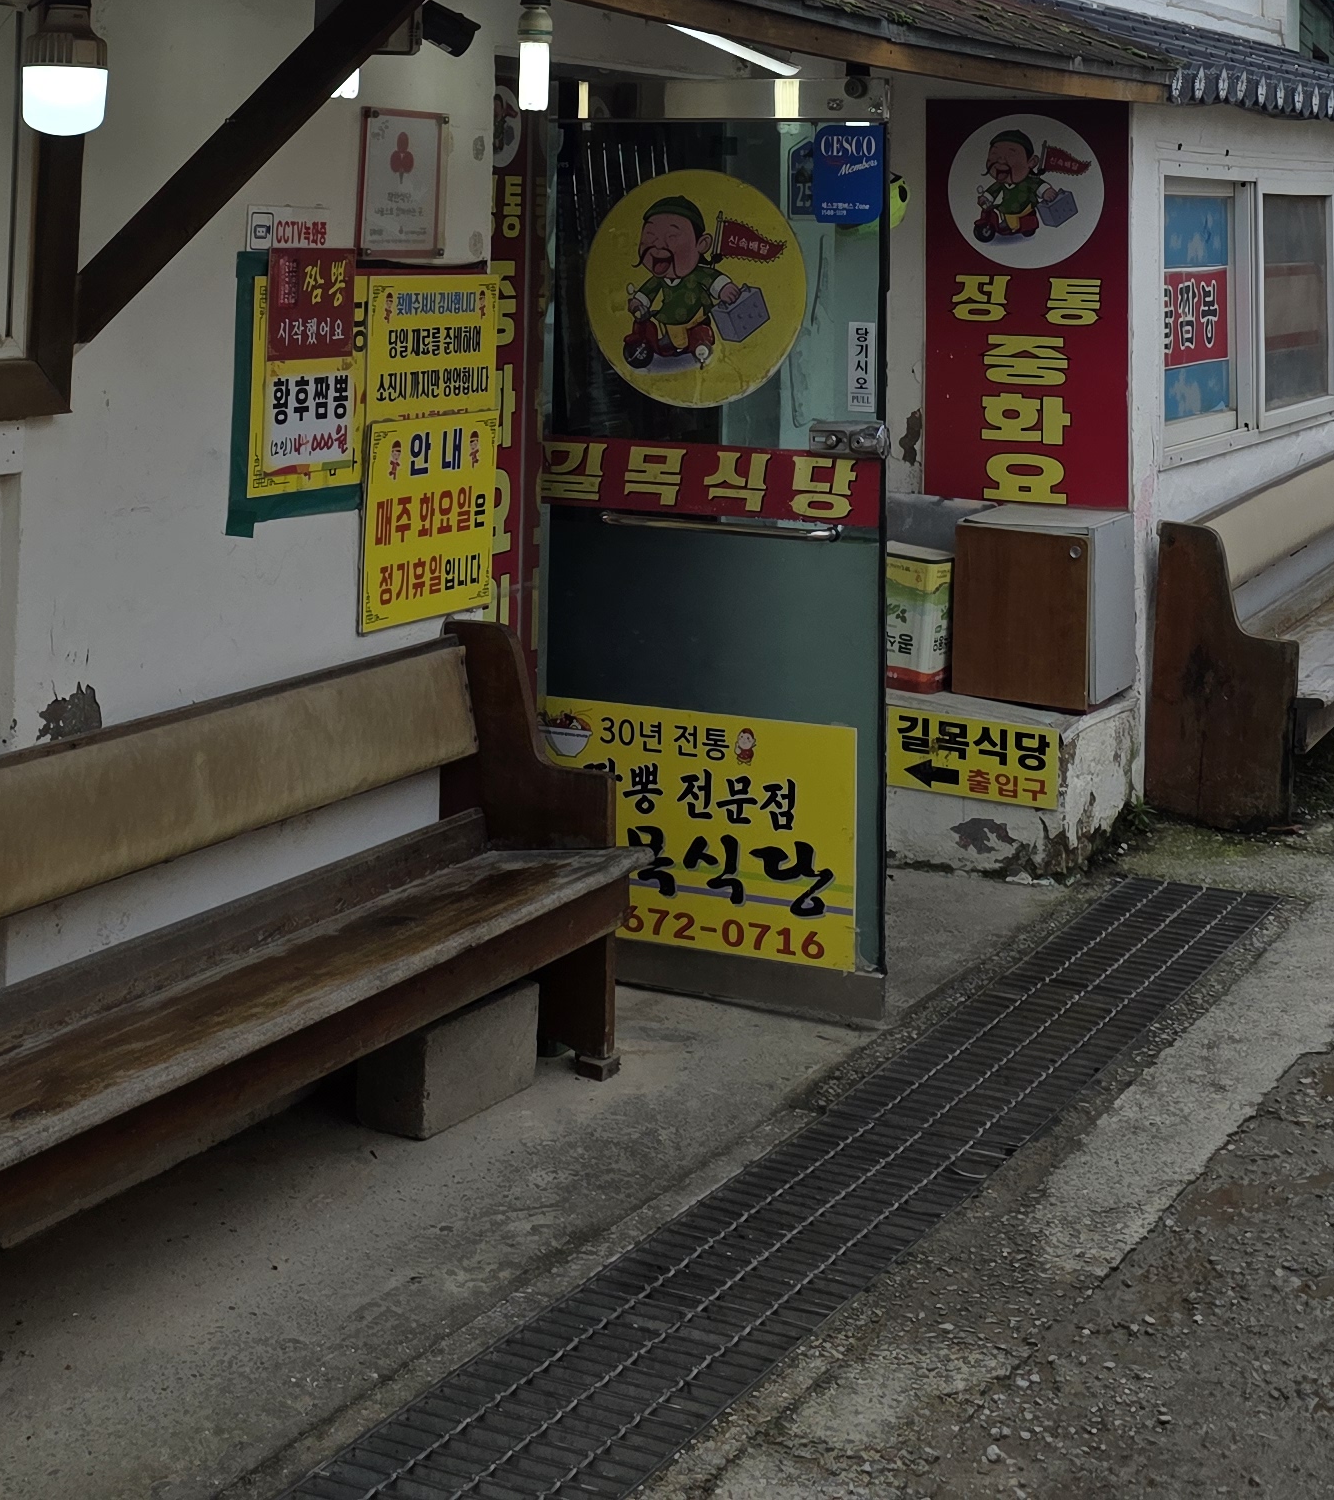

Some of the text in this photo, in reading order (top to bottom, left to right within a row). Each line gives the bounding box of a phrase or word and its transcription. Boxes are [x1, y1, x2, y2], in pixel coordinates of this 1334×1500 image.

[821, 135, 876, 156] CESCO
[838, 157, 878, 176] Members
[728, 236, 769, 255] 신속배달
[303, 259, 347, 308] 짬뽕
[396, 291, 477, 316] 찾아주셔서 감사합니다
[277, 317, 345, 347] 시작했어요
[388, 325, 481, 359] 당일 재료를 준비하여
[854, 327, 869, 389] 당기시오
[272, 374, 349, 425] 황후짬뽕
[376, 365, 489, 402] 소진시 까지만 영업합니다
[851, 395, 871, 404] PULL
[541, 441, 858, 519] 길목식당
[375, 486, 486, 546] 매주 화요일은
[379, 553, 481, 606] 정기휴일입니다
[599, 717, 730, 762] 30년 전통
[895, 713, 1051, 771] 길목식당
[677, 769, 797, 832] 전문점
[967, 768, 1048, 804] 출입구
